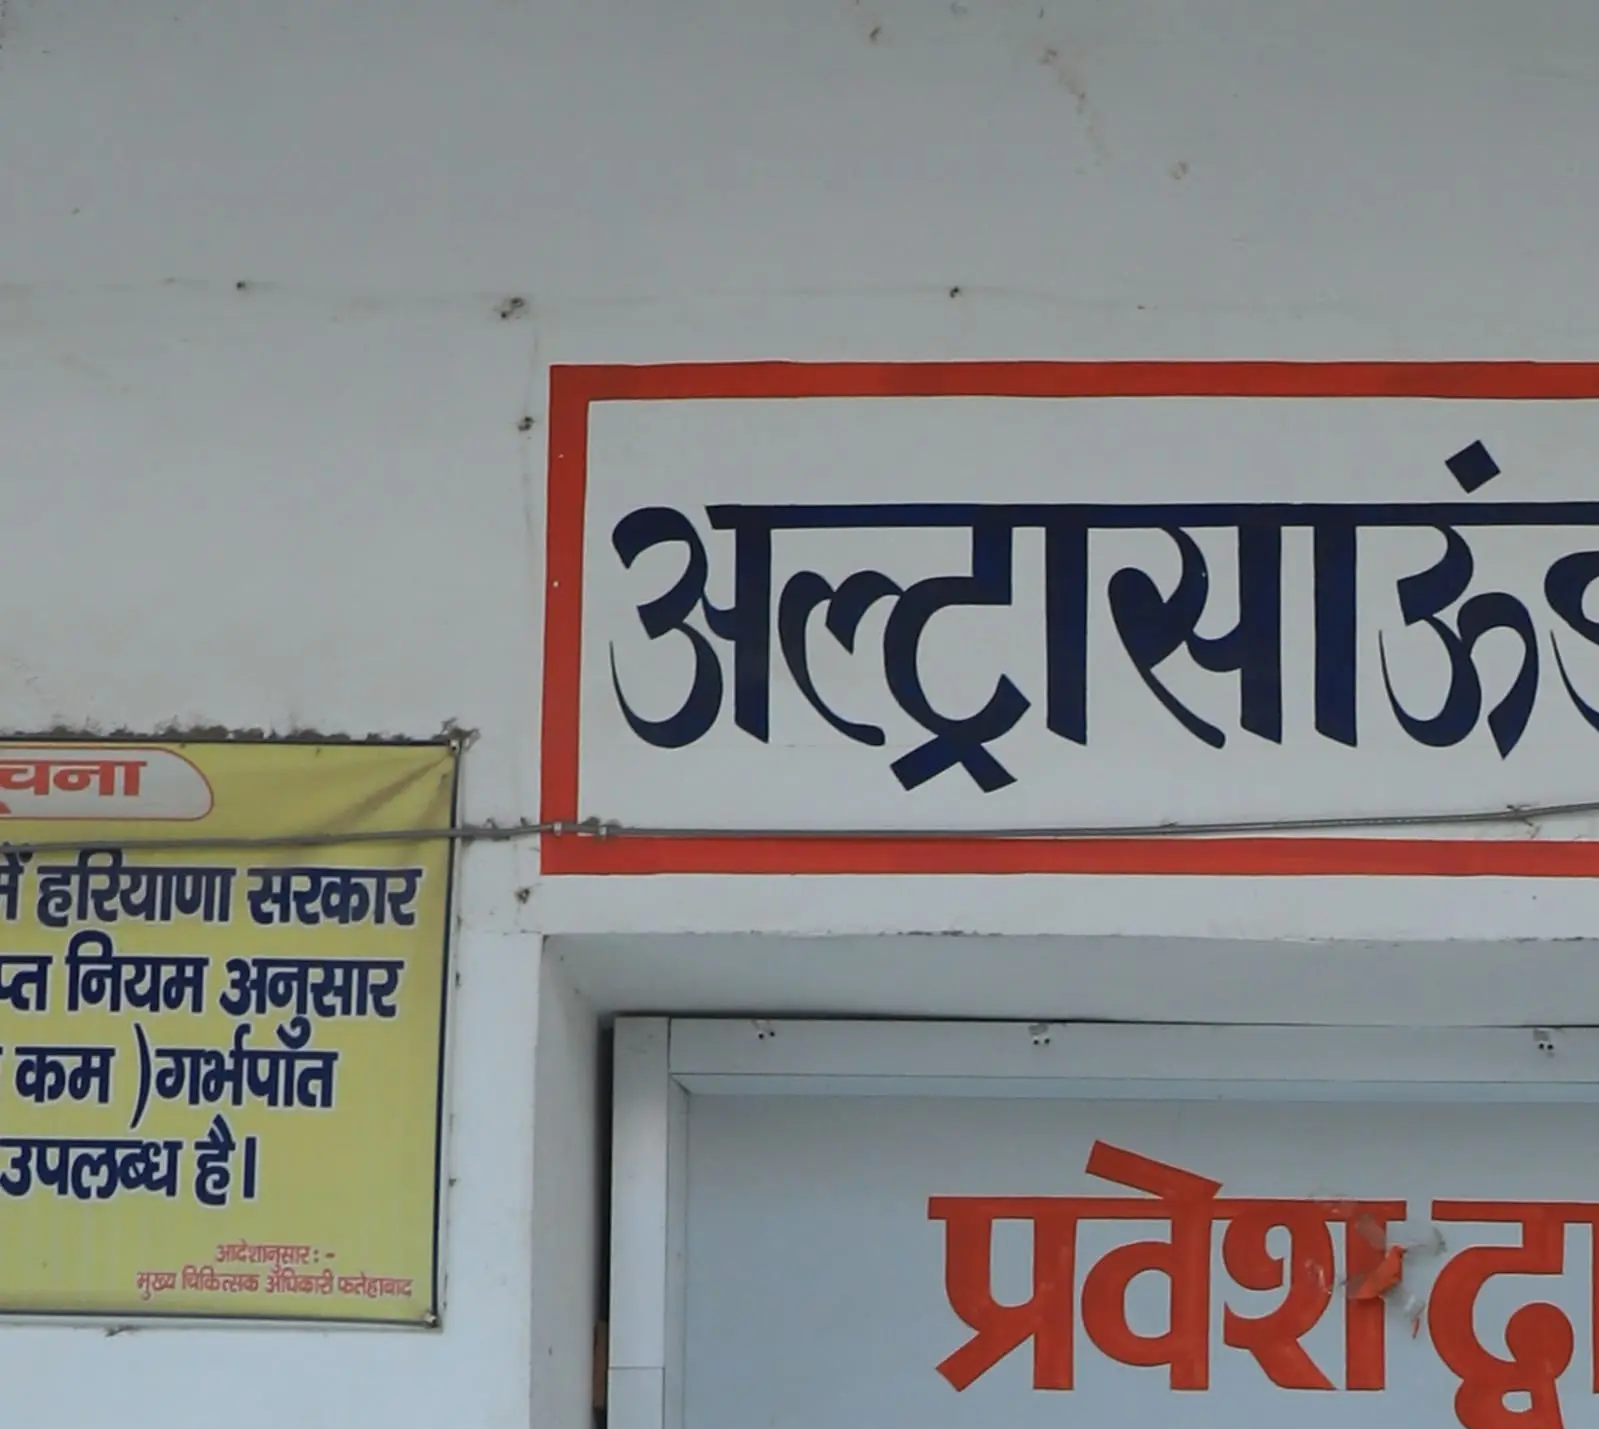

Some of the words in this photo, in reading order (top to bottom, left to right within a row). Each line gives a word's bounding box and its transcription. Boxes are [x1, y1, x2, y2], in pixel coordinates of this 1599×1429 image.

[37, 849, 237, 927] हरियाणा
[247, 868, 422, 926] सरकार
[65, 930, 209, 1013] नियम
[219, 957, 403, 1048] अनुसार
[15, 1046, 116, 1103] कम
[0, 1138, 183, 1199] उपलब्ध
[928, 1140, 1407, 1392] प्रवेश
